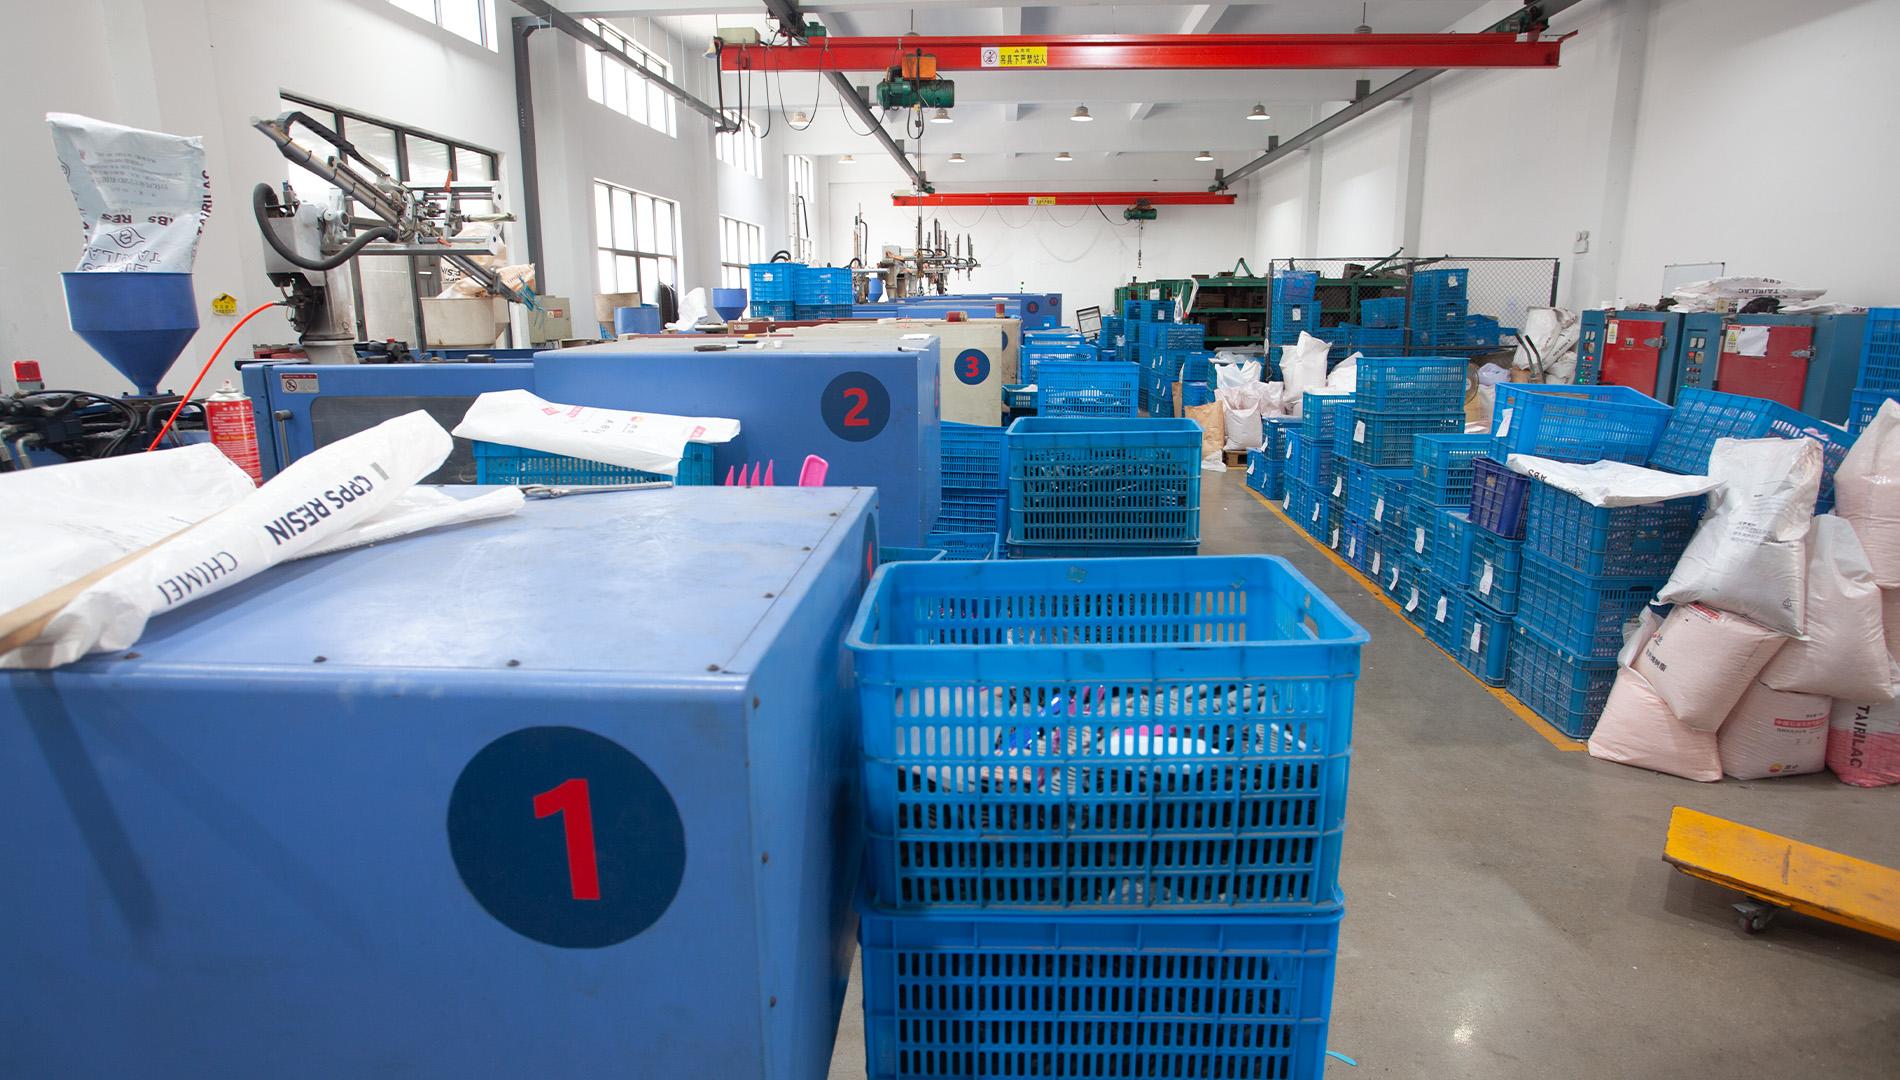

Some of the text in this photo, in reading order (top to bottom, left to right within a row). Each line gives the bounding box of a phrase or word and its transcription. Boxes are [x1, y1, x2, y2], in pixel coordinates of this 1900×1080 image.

[148, 217, 173, 226] BS
[965, 356, 979, 377] 3
[843, 387, 870, 426] 2
[264, 498, 332, 545] RESIN
[157, 551, 238, 605] CHIMEI
[1850, 705, 1870, 768] TAIRILAC
[533, 778, 600, 900] 1
